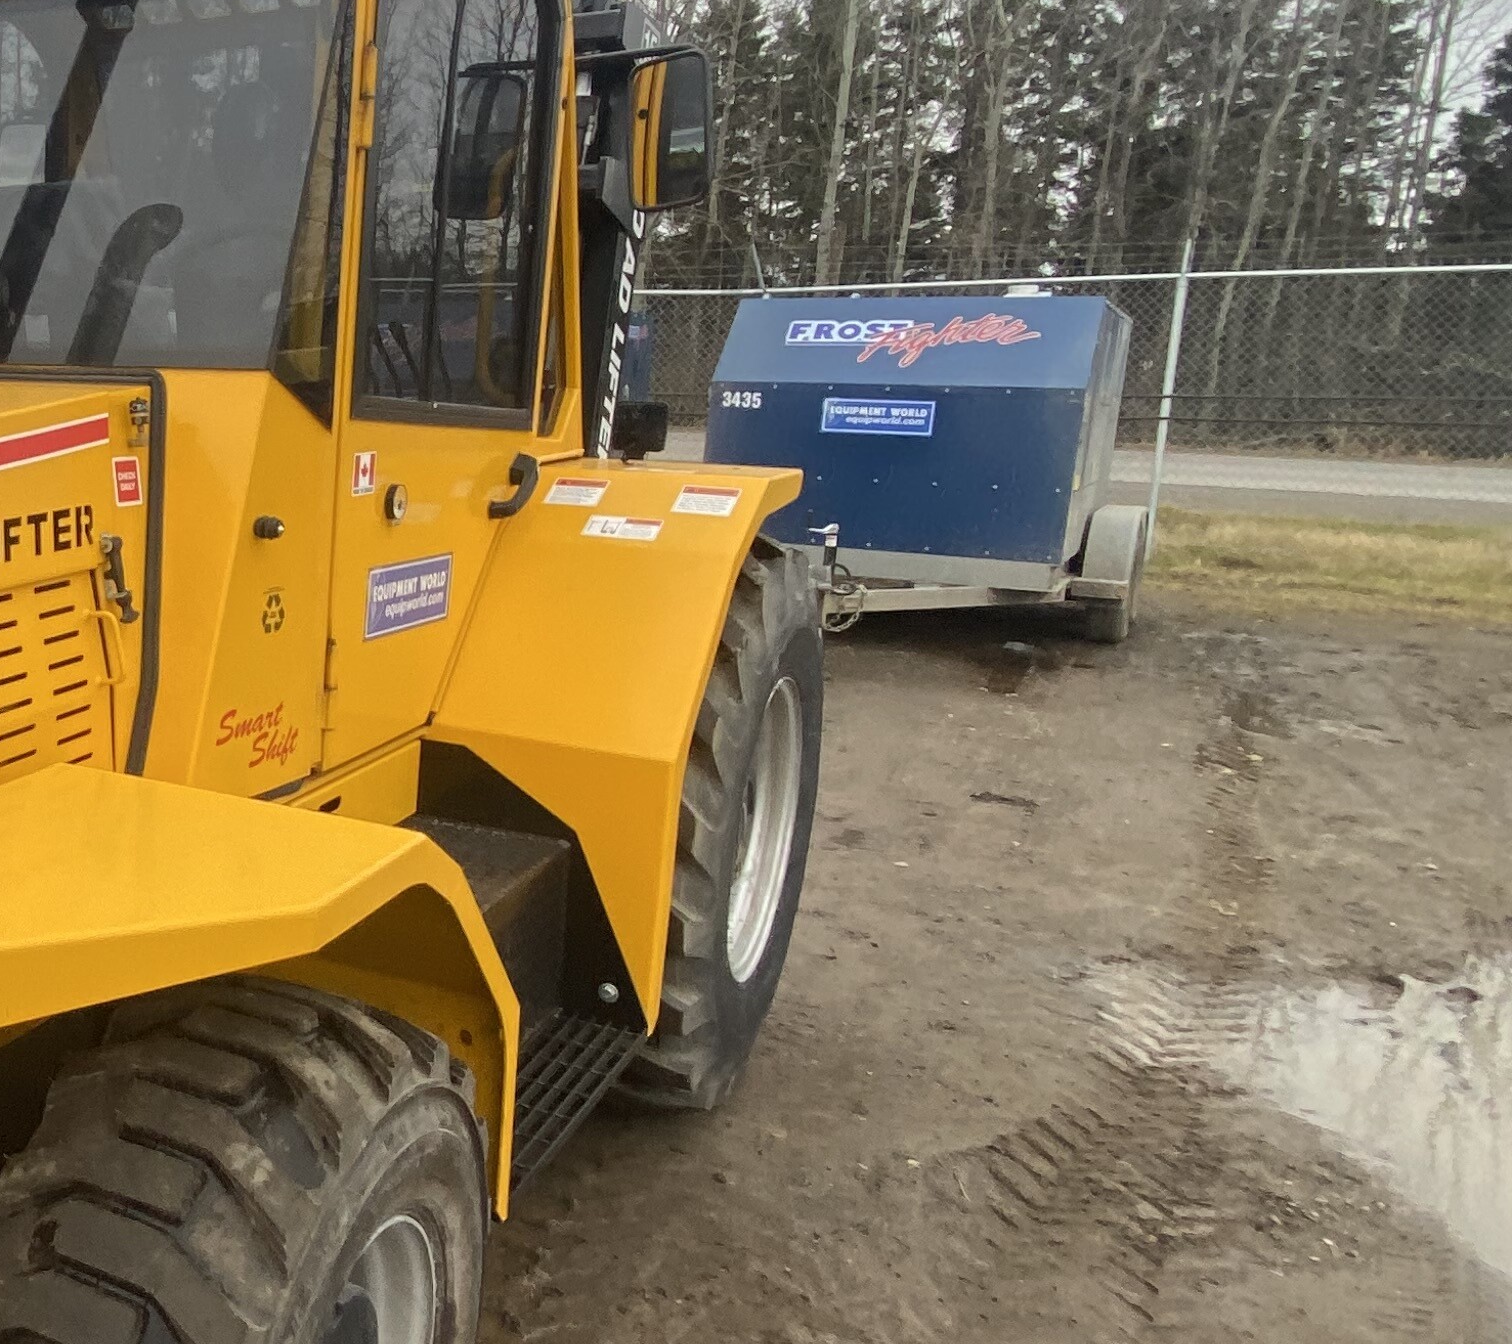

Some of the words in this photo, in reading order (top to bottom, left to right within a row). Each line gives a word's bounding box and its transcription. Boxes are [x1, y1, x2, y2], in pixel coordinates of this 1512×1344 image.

[619, 209, 645, 314] OAD
[857, 313, 1041, 368] Fighter
[721, 391, 762, 409] 3435
[829, 406, 888, 417] EQUIPMENT
[890, 407, 928, 418] WORLD
[844, 416, 926, 426] equipworld.com
[373, 576, 419, 603] EQUIPMENT
[420, 570, 447, 592] WORLD
[384, 590, 444, 618] equipworld.com
[215, 701, 284, 747] Smart
[248, 723, 299, 768] Shift
